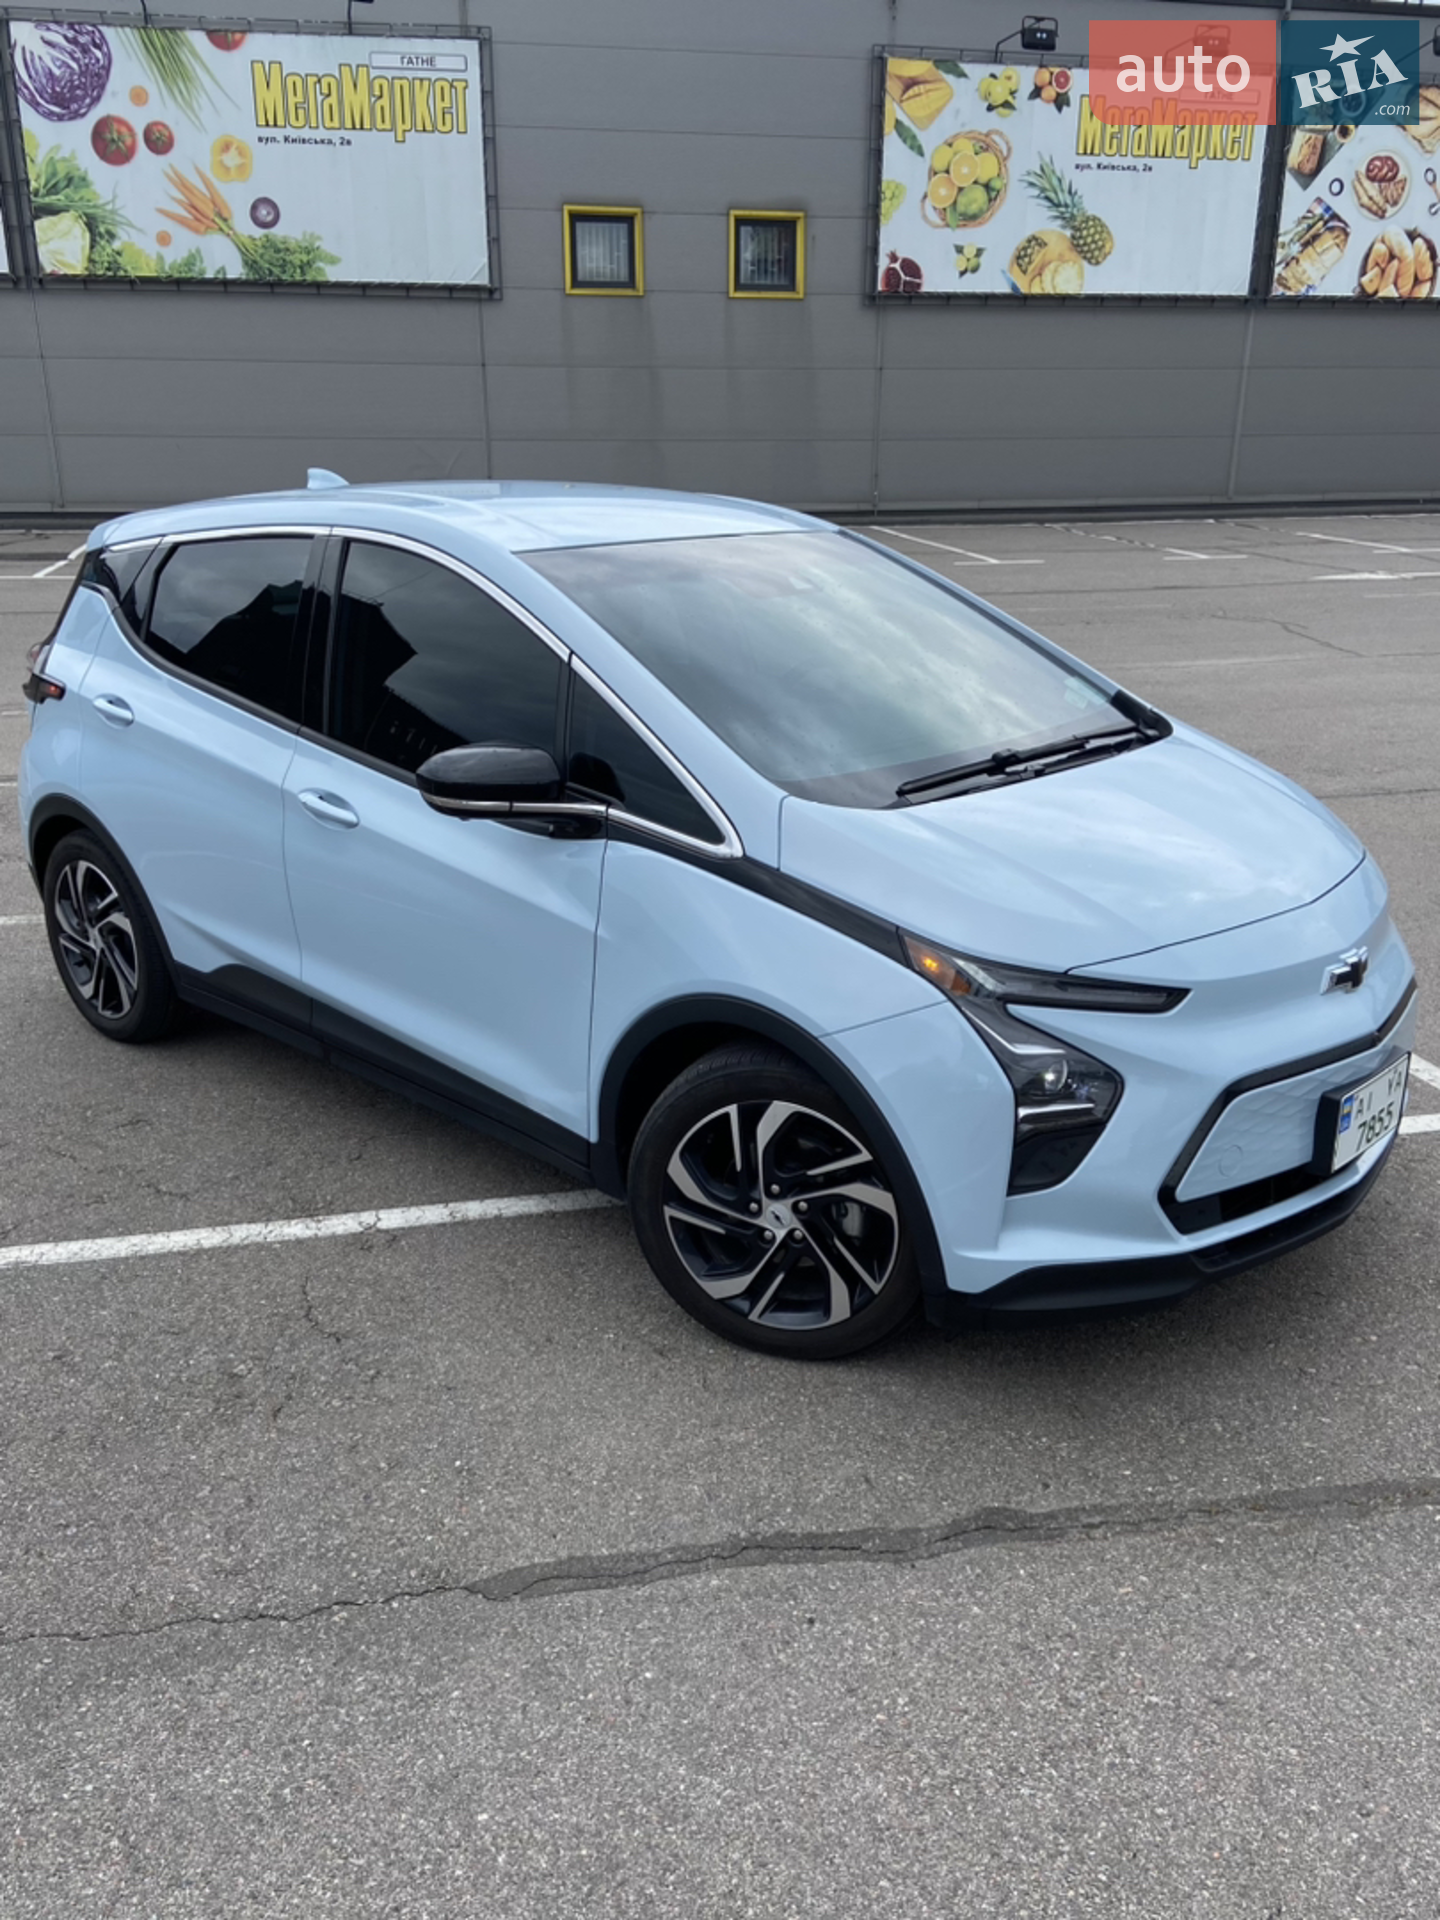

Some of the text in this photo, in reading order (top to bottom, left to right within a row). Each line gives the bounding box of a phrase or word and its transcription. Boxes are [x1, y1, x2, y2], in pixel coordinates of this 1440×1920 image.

[400, 55, 437, 67] ГАТНЕ
[251, 60, 469, 143] МегаМаркет
[257, 135, 280, 145] вул.
[283, 134, 337, 147] Київська,
[1076, 94, 1258, 170] МегаМаркет
[1355, 1101, 1395, 1153] 7855
